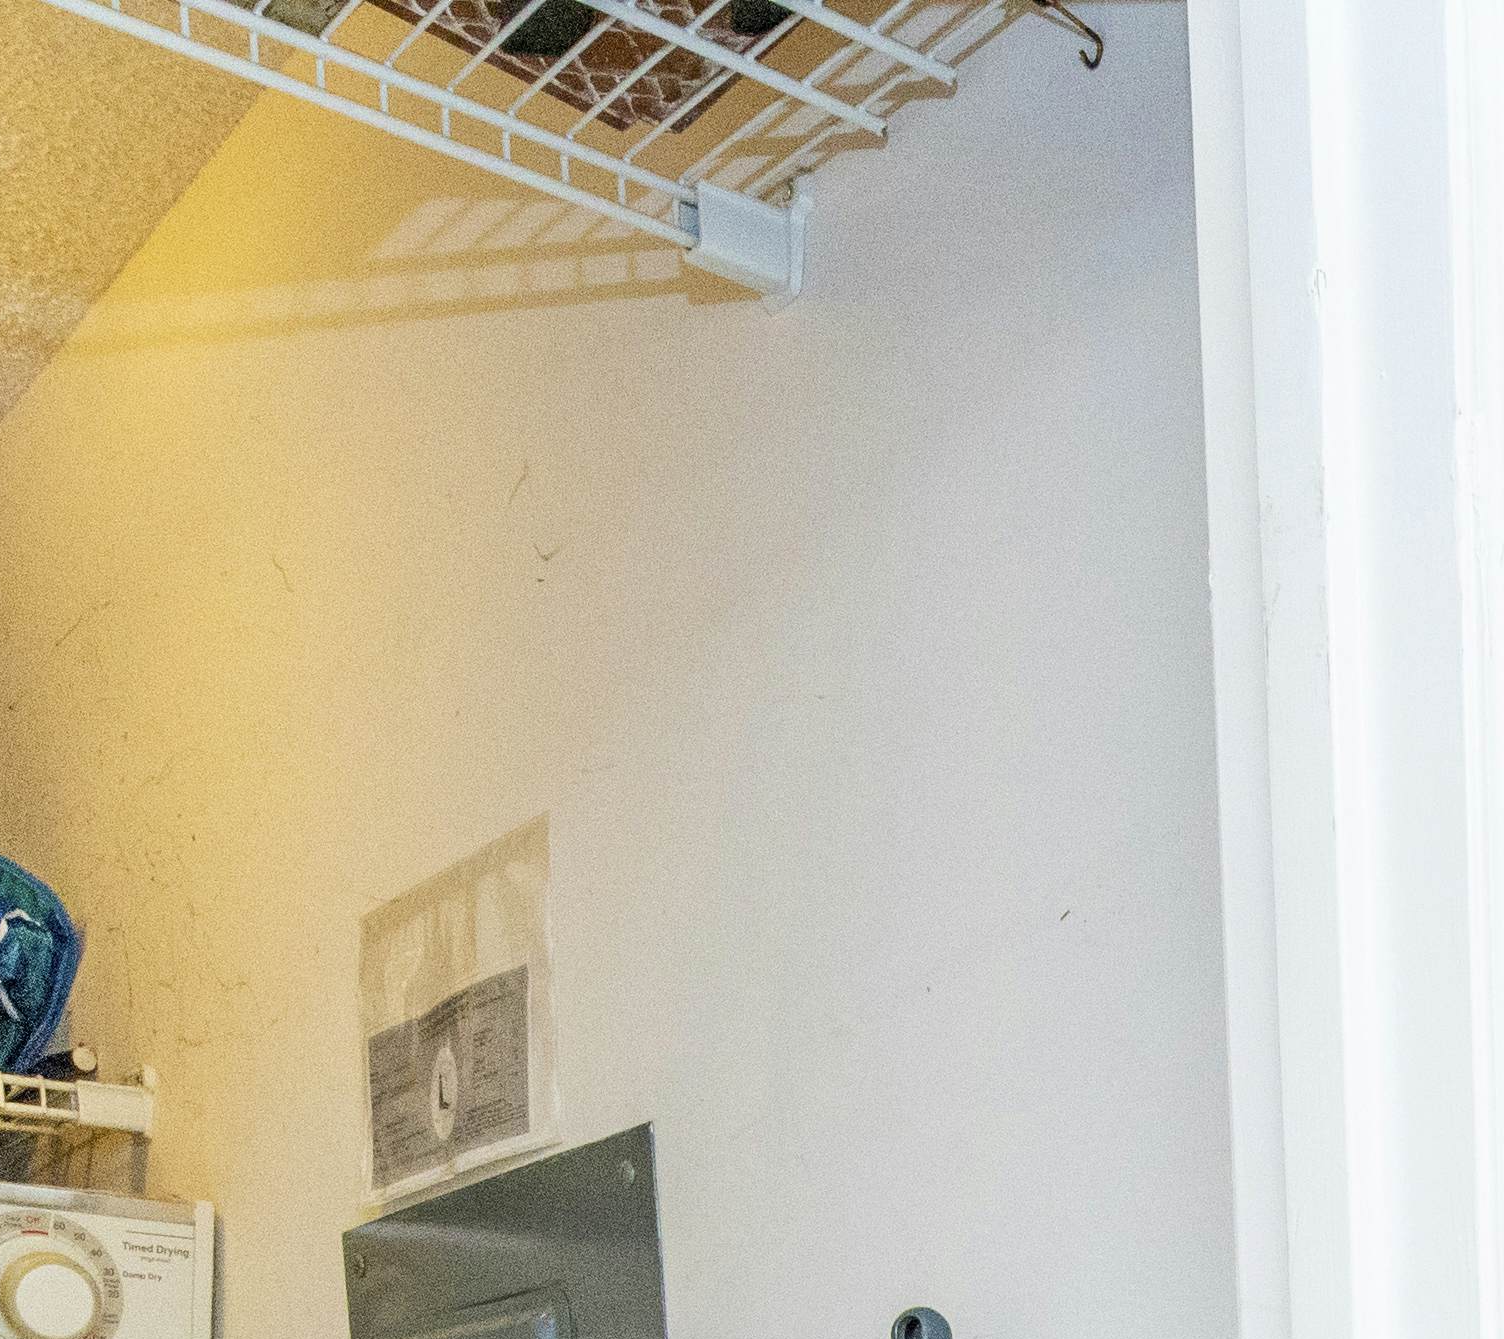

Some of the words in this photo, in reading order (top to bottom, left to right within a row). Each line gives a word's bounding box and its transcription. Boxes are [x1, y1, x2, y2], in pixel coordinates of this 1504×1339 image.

[122, 1241, 153, 1253] Timed
[156, 1245, 190, 1260] Drying
[122, 1270, 146, 1280] Damp
[148, 1272, 163, 1282] Dry
